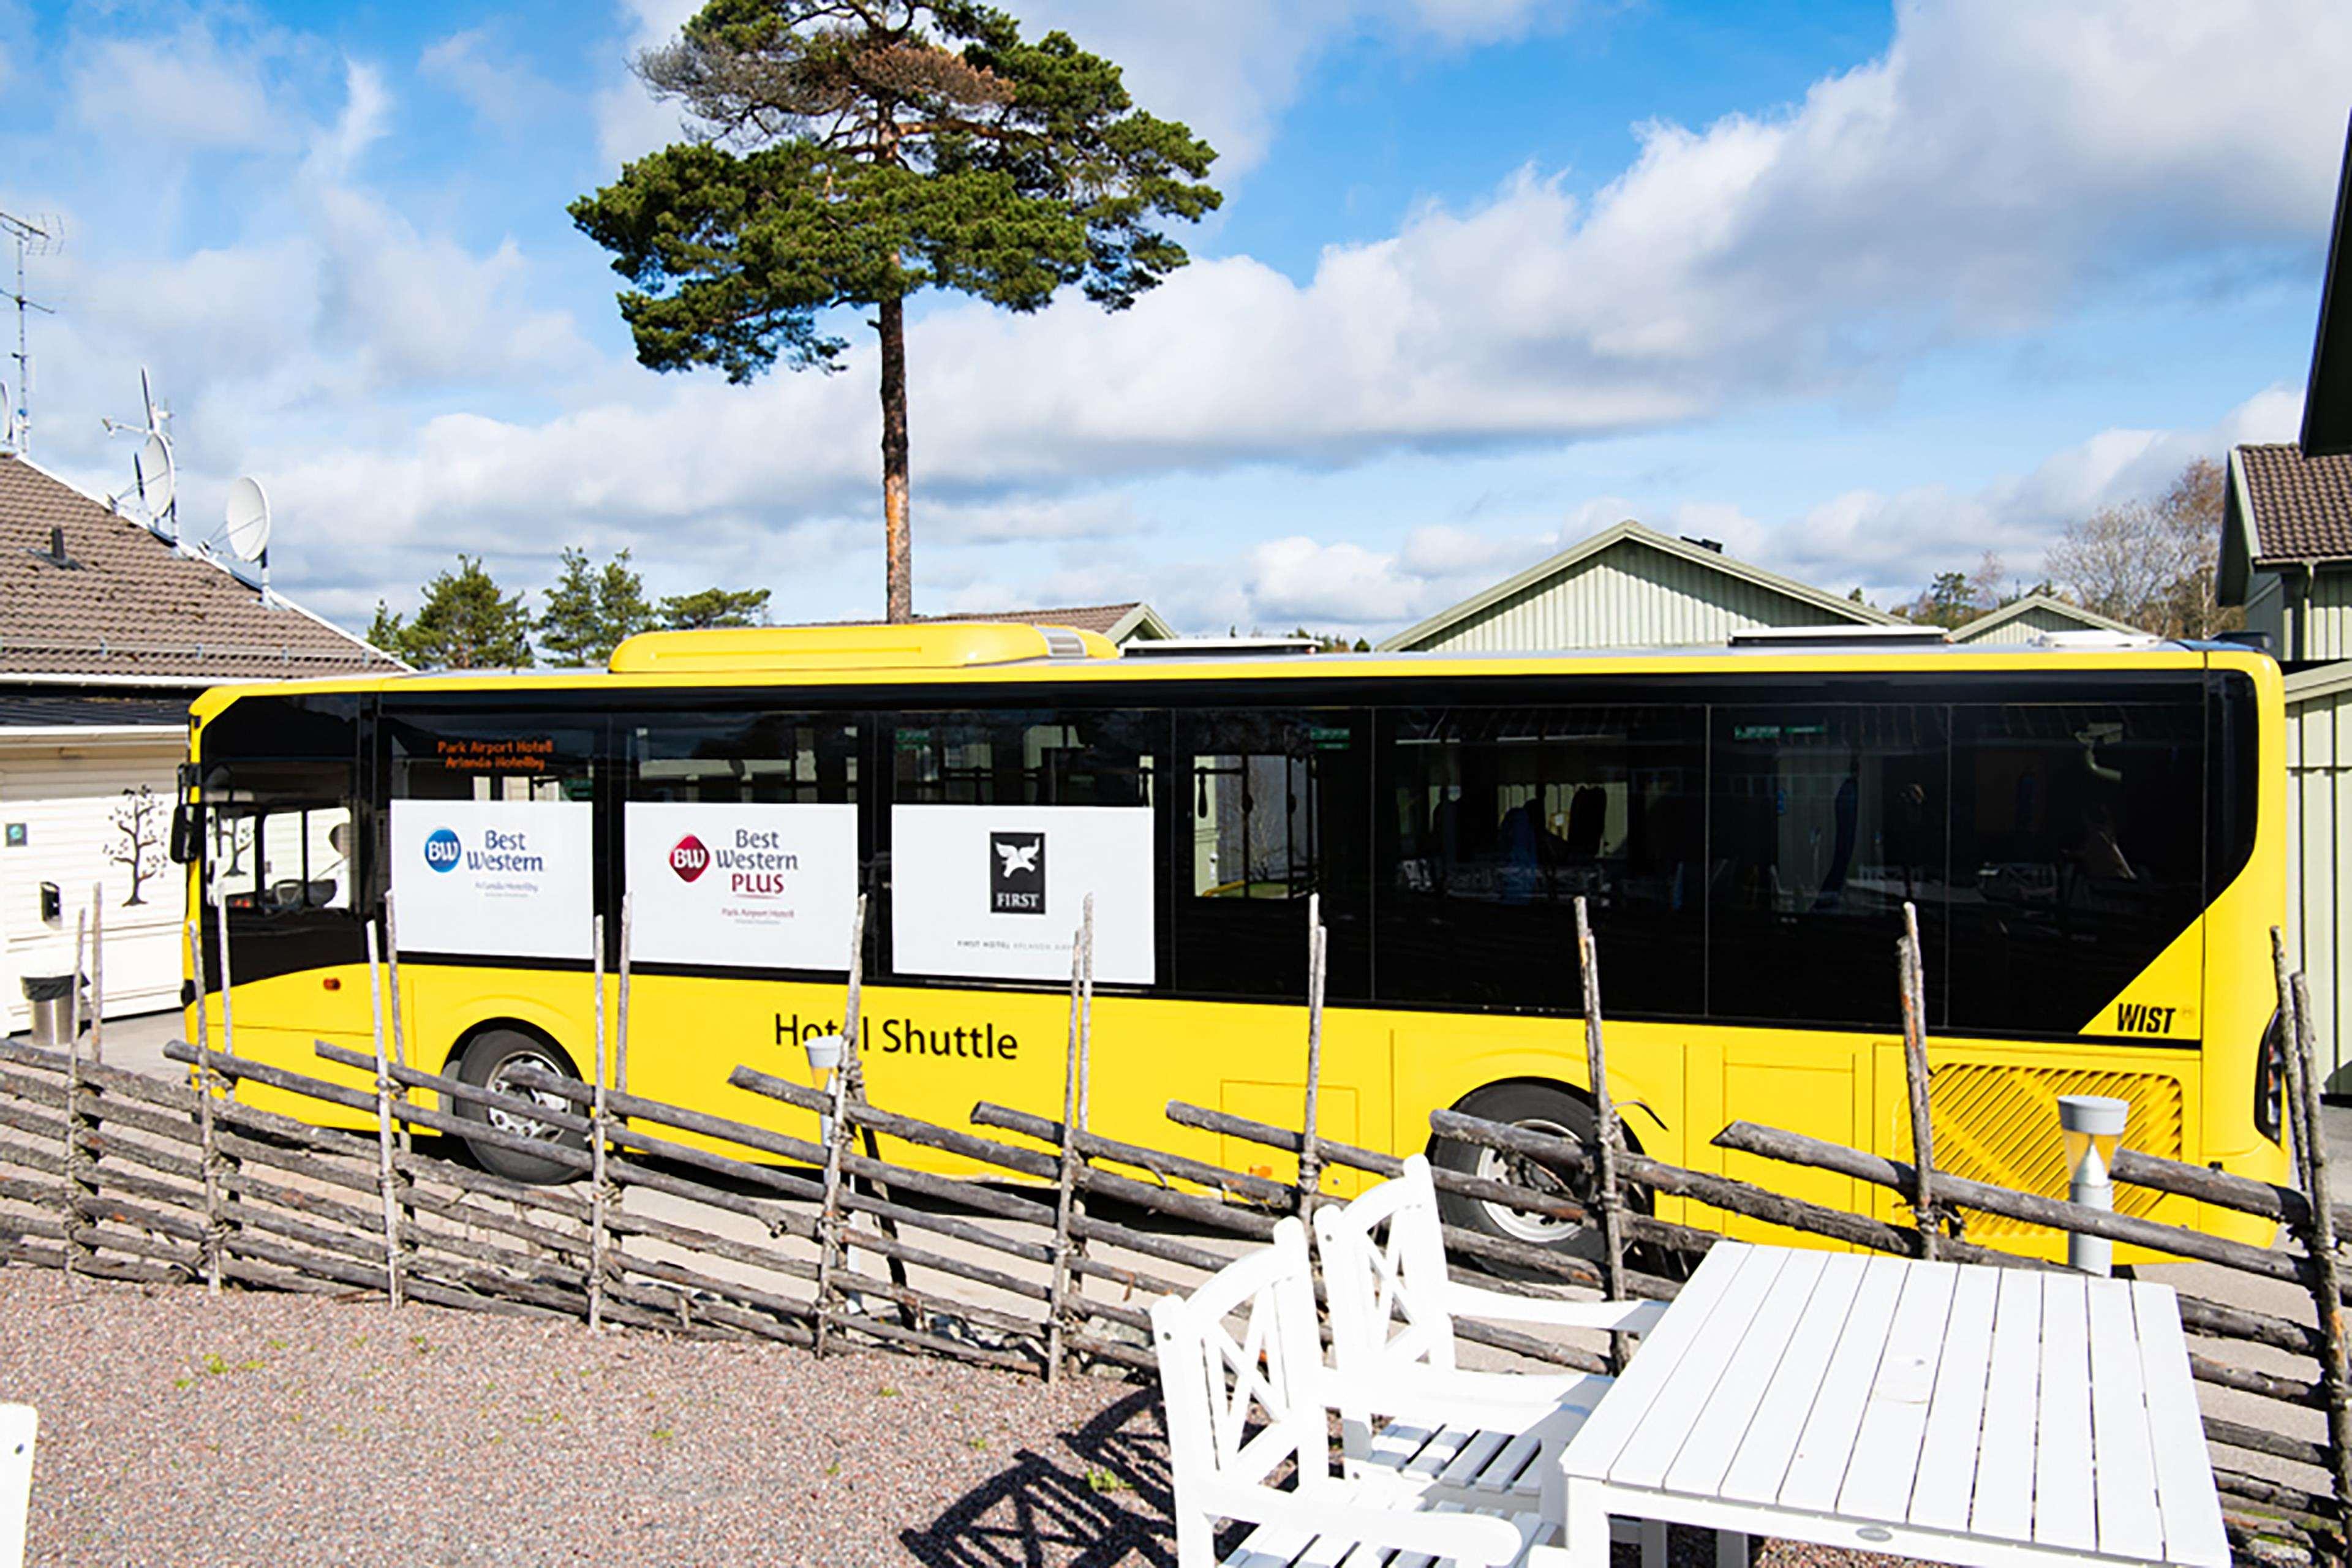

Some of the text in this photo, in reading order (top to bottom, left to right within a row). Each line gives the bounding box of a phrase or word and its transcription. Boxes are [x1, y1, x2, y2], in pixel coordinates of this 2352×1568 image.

[438, 741, 466, 753] Park
[470, 741, 513, 755] Airport
[446, 756, 492, 768] Arlanda
[486, 830, 526, 850] Best
[736, 829, 779, 848] Best
[429, 842, 458, 861] BW
[675, 849, 706, 868] BW
[717, 850, 798, 870] Western
[467, 852, 543, 872] Western
[731, 873, 784, 894] PLUS
[997, 892, 1039, 907] FIRST
[2118, 1003, 2176, 1033] WIST
[775, 1014, 1017, 1060] Hotl Shuttle
